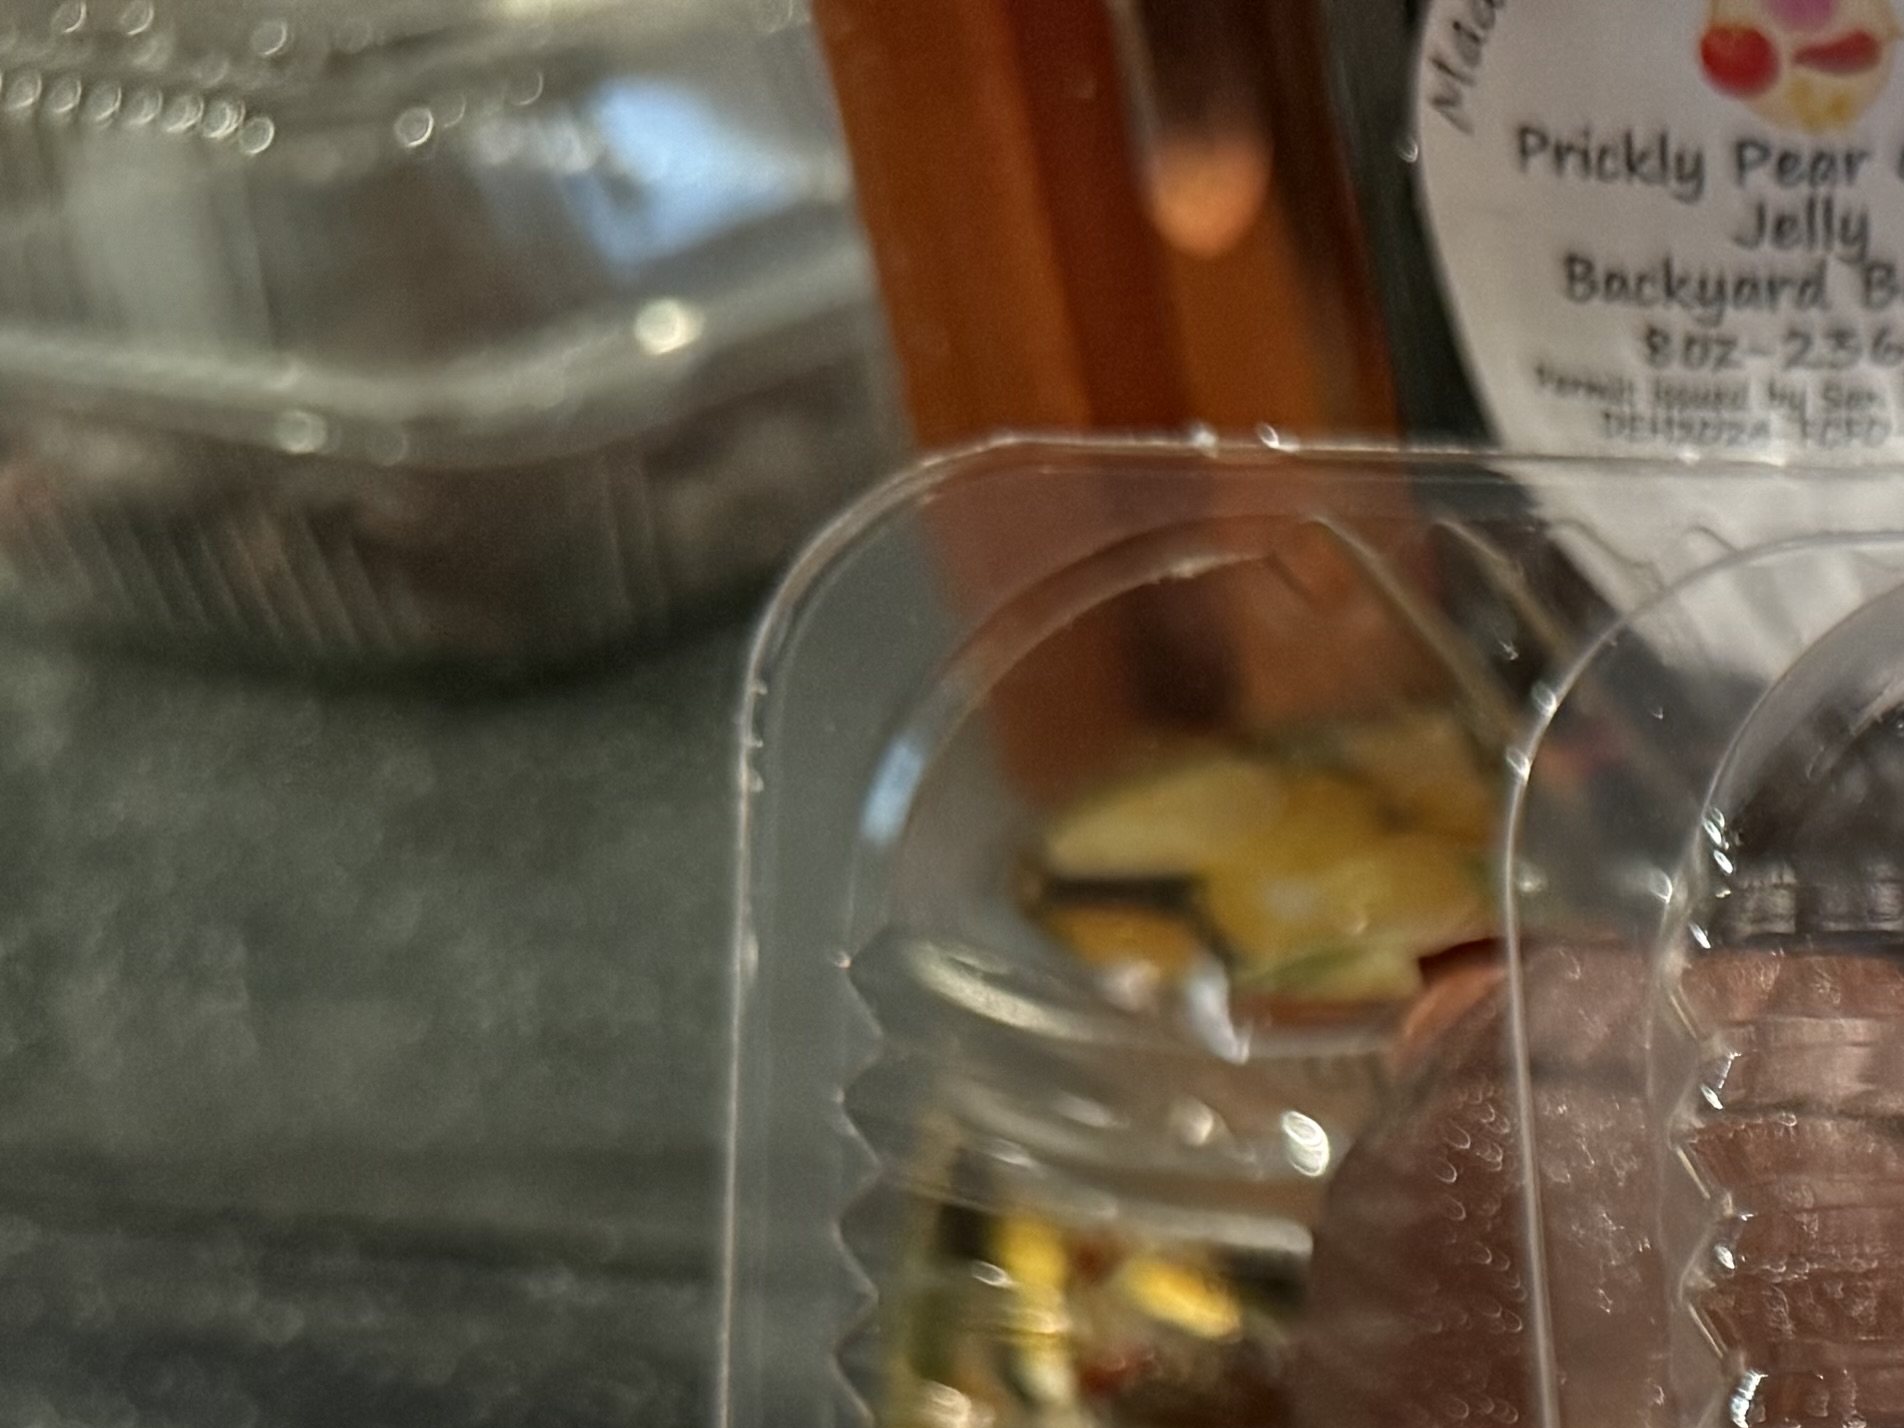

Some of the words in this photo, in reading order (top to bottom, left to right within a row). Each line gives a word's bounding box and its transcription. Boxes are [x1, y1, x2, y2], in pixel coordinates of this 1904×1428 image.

[1516, 124, 1705, 205] Prickly
[1734, 137, 1872, 189] Pear
[1731, 194, 1870, 264] Jelly
[1563, 250, 1828, 328] Backyard
